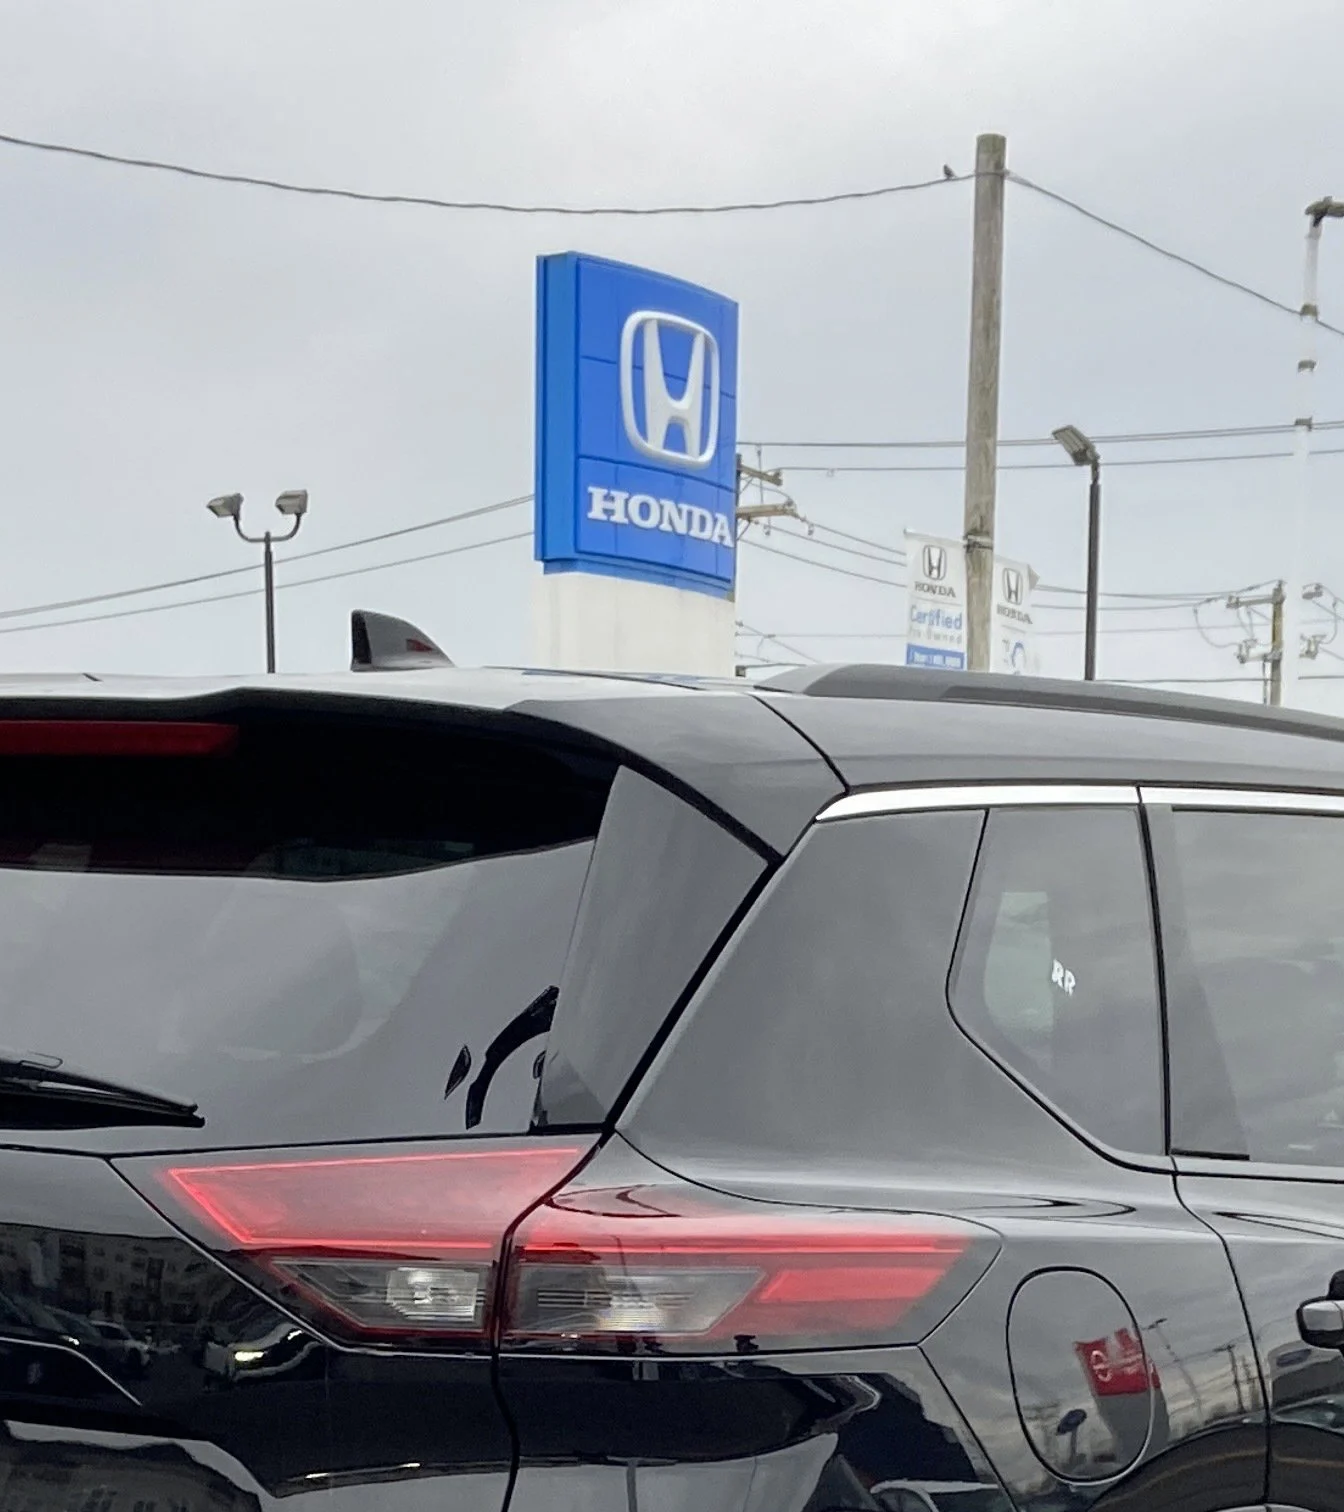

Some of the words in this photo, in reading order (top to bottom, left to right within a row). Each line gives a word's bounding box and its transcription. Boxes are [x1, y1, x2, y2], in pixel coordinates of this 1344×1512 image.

[587, 485, 736, 549] HONDA
[914, 580, 957, 598] HONDA
[909, 604, 963, 631] Certified
[996, 603, 1033, 625] HONDA
